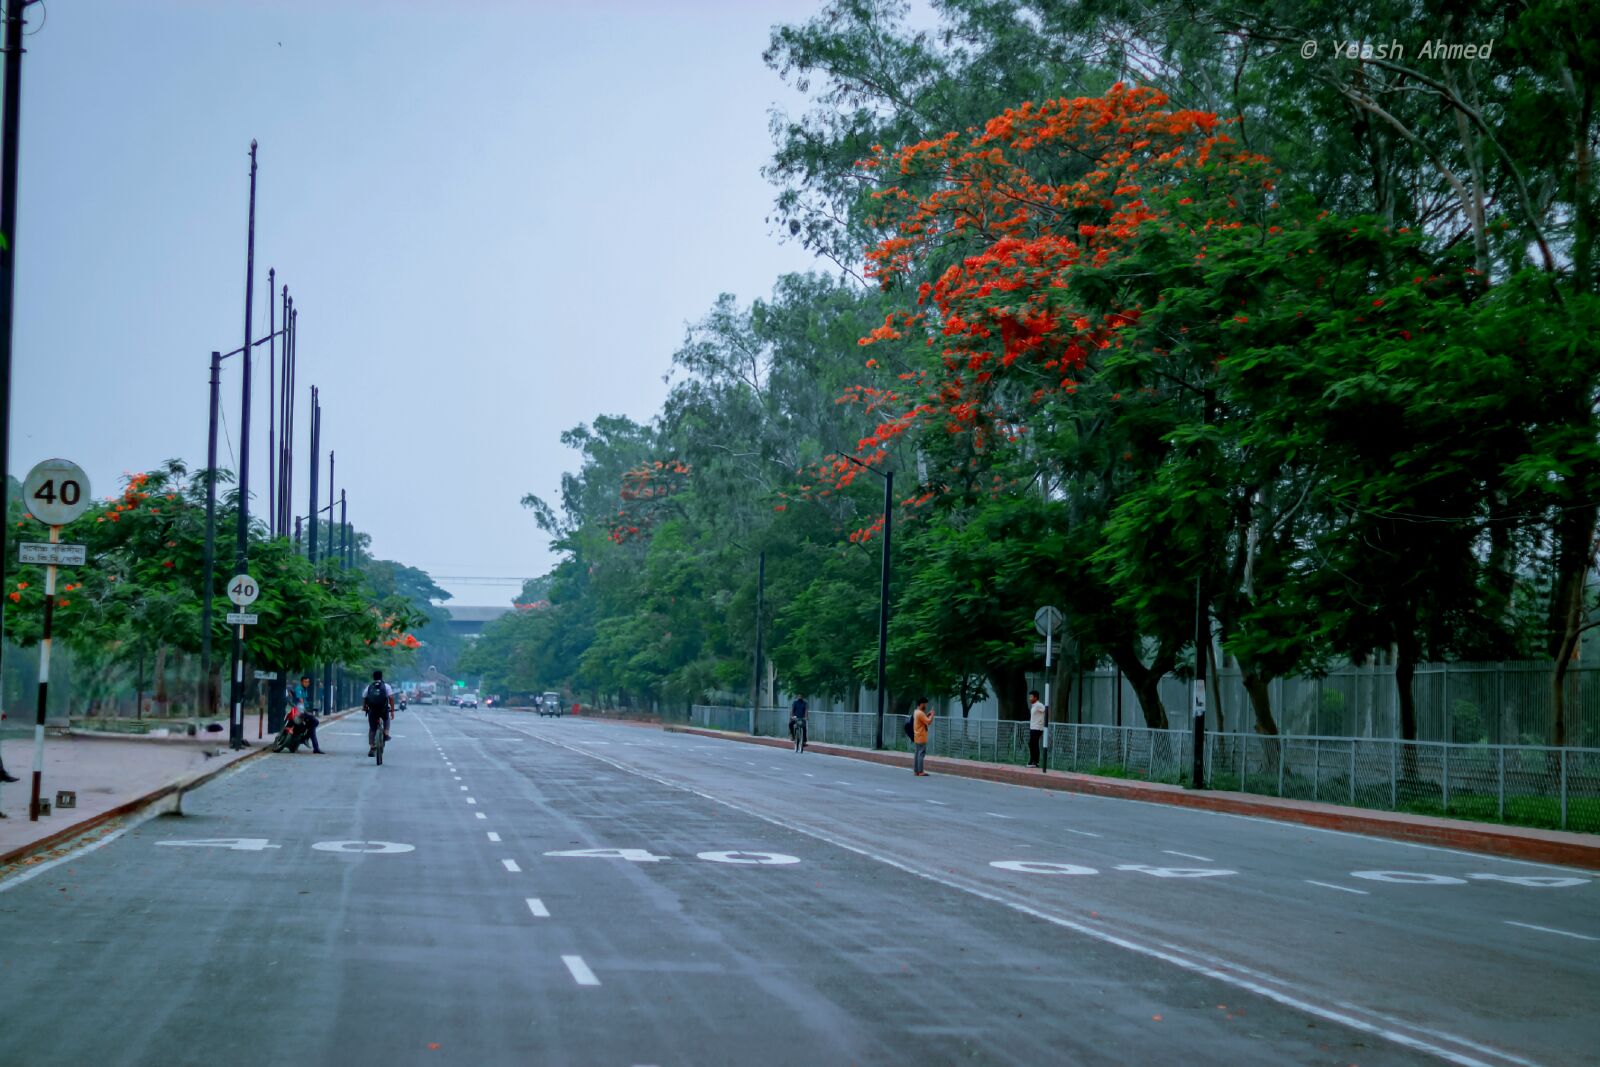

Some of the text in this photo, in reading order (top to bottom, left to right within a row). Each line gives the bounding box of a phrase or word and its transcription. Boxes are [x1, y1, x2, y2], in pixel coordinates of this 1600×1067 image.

[34, 479, 80, 506] 40
[231, 583, 254, 597] 40
[154, 838, 416, 853] 40
[541, 848, 801, 865] 40
